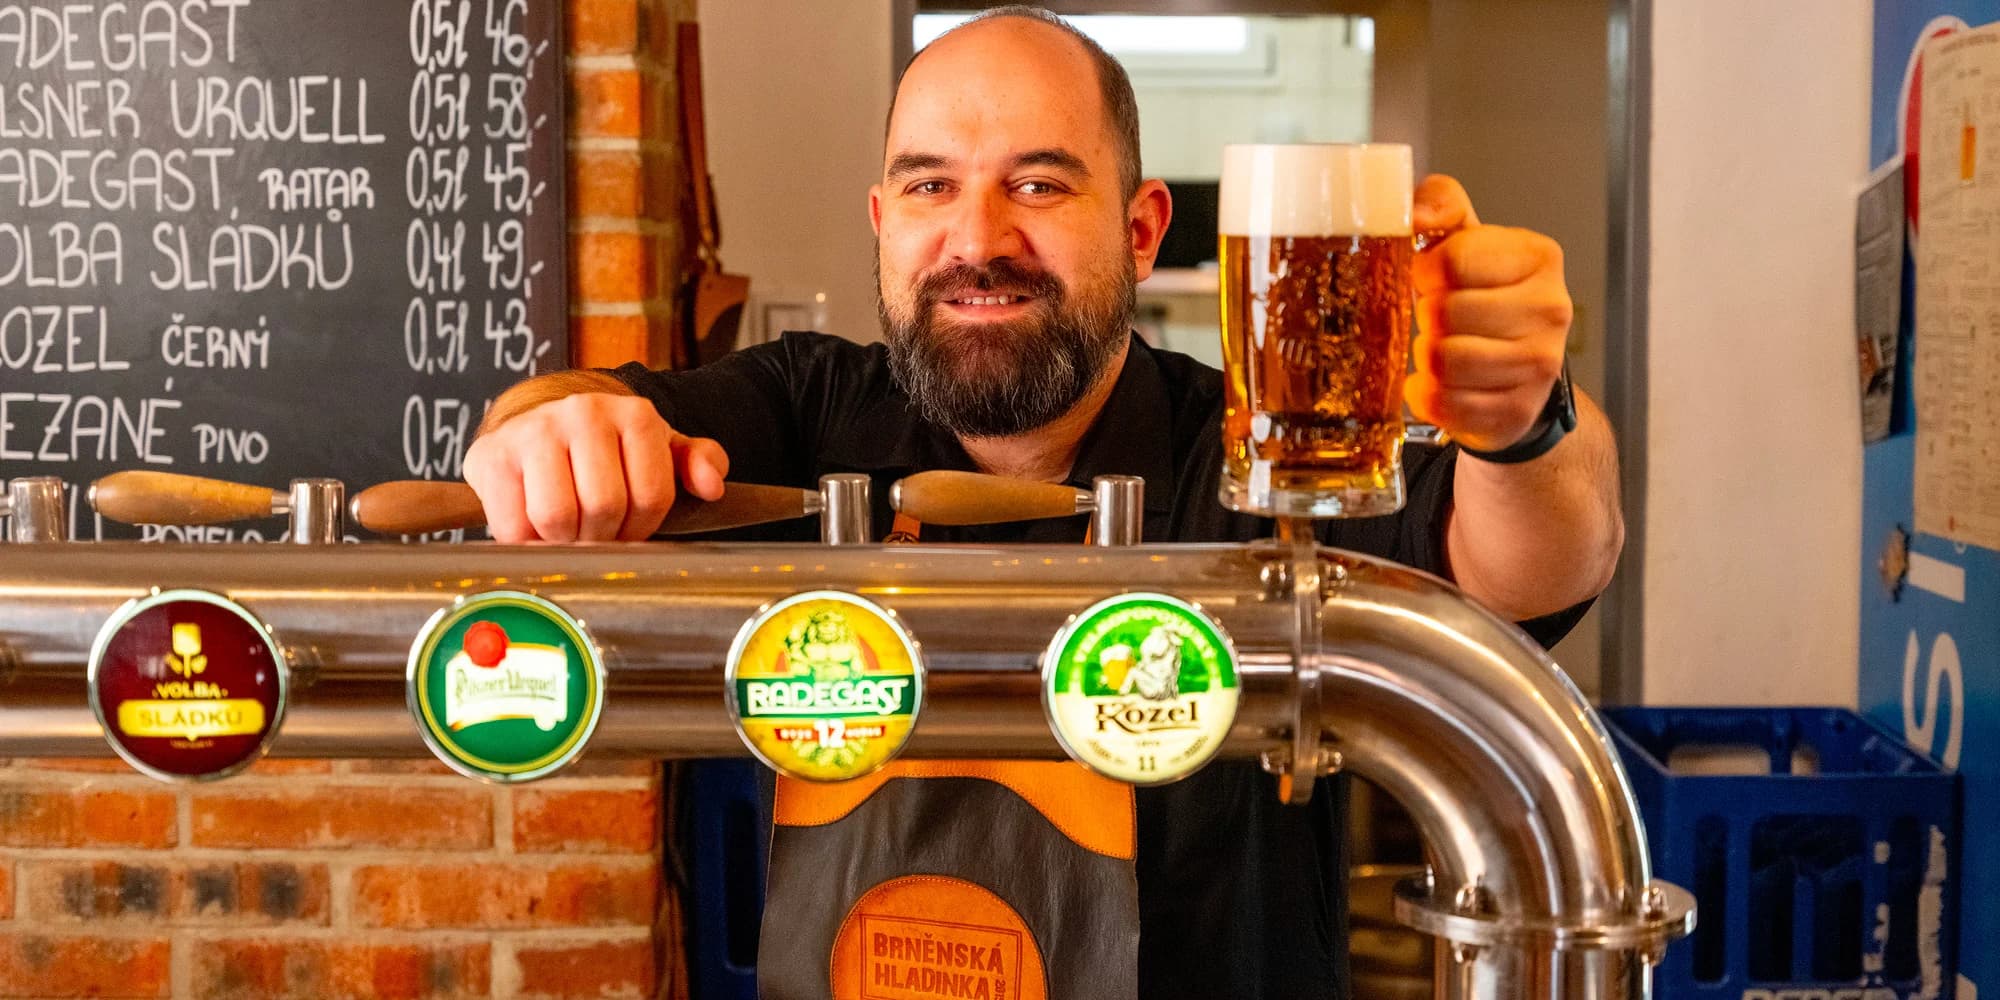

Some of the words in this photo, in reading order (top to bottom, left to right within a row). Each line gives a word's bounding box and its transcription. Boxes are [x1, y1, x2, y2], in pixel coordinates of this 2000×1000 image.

[0, 0, 250, 71] ADEGAST
[0, 79, 140, 140] LSNER
[171, 75, 386, 144] URQUELL
[0, 148, 235, 212] ADEGAST
[258, 167, 375, 212] RATAR
[150, 207, 353, 292] SLÁDKŮ
[0, 305, 130, 373] OZEL
[162, 313, 270, 369] ČERNÝ
[0, 377, 182, 464] EZANÉ
[192, 423, 269, 464] PIVO
[156, 681, 222, 699] VOLBA
[746, 679, 909, 715] RADEGAST
[813, 719, 846, 749] 12
[1096, 701, 1200, 735] Kozel
[873, 932, 1004, 975] BRNĚNSKÁ
[874, 963, 990, 1000] HLADINKA
